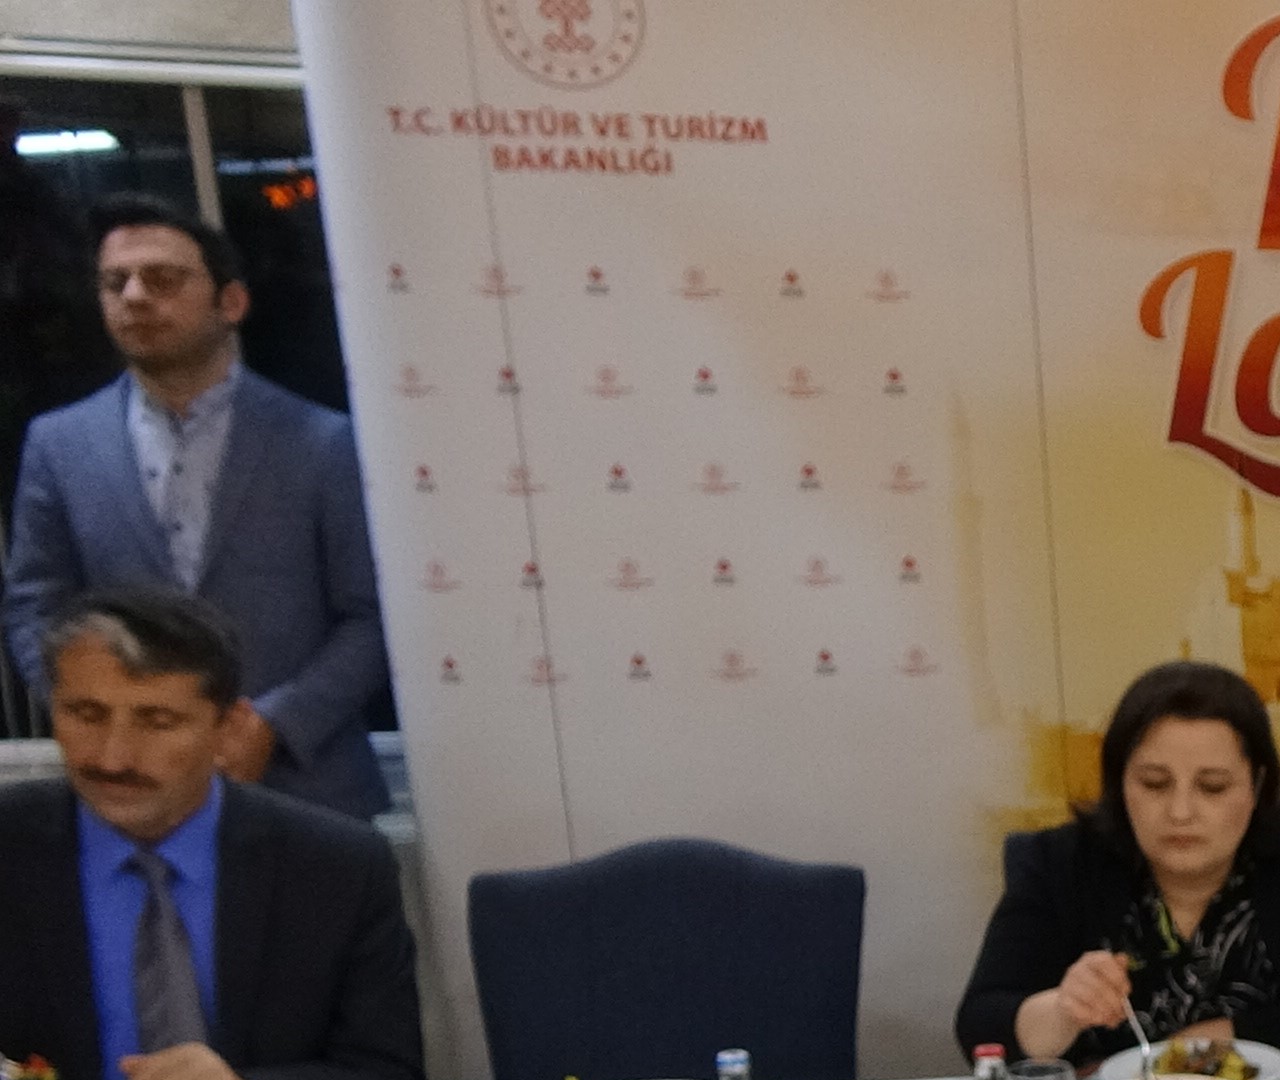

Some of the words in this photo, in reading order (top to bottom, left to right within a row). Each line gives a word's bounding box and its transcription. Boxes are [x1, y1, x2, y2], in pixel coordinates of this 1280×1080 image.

[387, 106, 442, 135] T.C.
[450, 102, 582, 138] KÜLTÜR
[591, 112, 632, 138] VE
[642, 110, 769, 143] TURİZM
[491, 143, 674, 176] BAKANLIĞI
